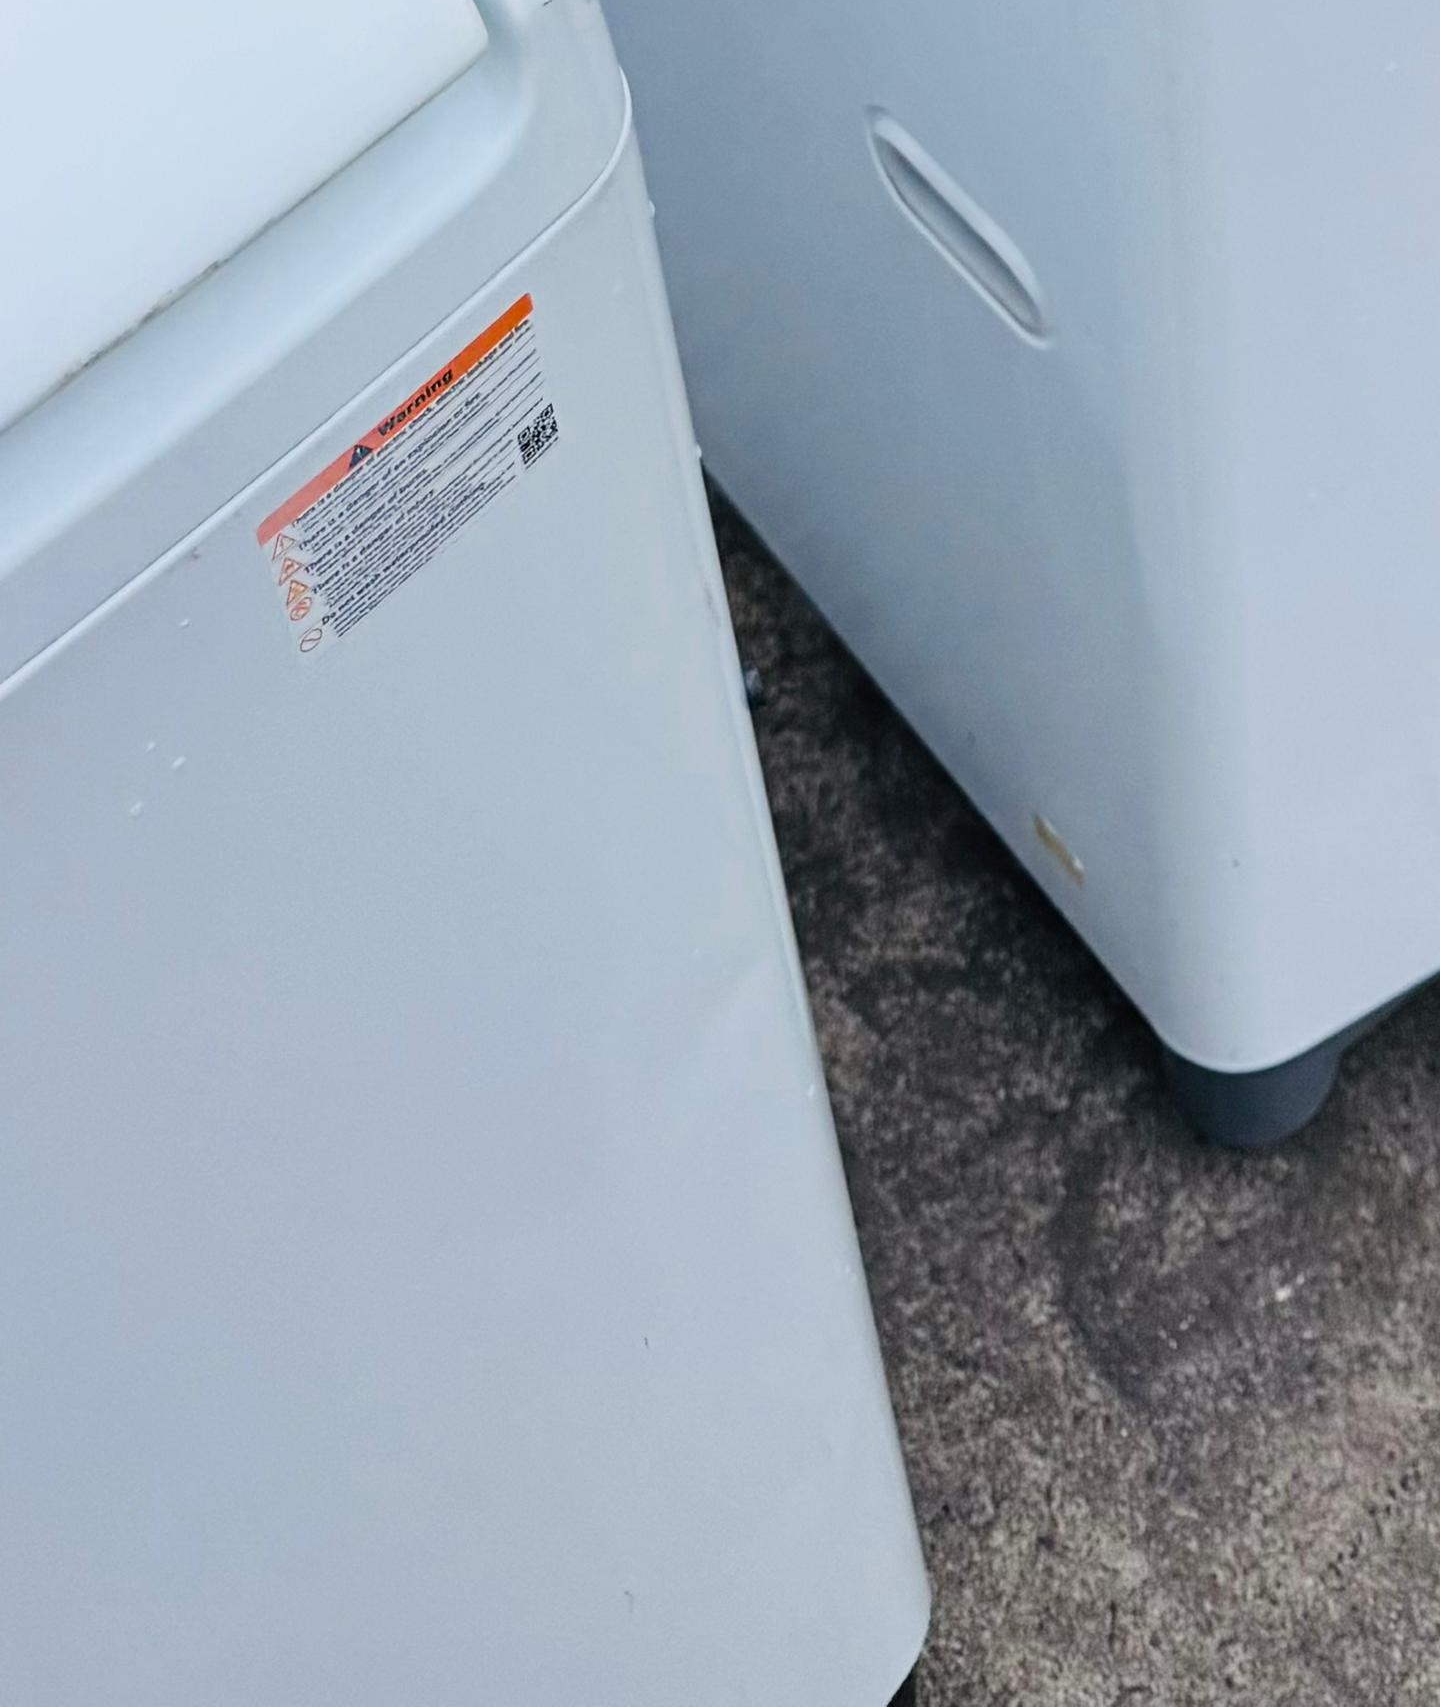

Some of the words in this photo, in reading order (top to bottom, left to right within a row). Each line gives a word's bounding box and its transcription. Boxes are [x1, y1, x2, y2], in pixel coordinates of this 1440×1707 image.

[377, 369, 455, 436] Warning
[298, 522, 326, 551] There
[344, 478, 380, 514] danger
[380, 465, 393, 483] of
[304, 546, 332, 574] There
[350, 500, 386, 536] danger
[386, 490, 398, 505] of
[312, 567, 340, 594] There
[358, 522, 394, 557] danger
[393, 511, 405, 526] of
[321, 608, 336, 625] Do
[337, 593, 355, 612] not
[355, 570, 381, 596] wash
